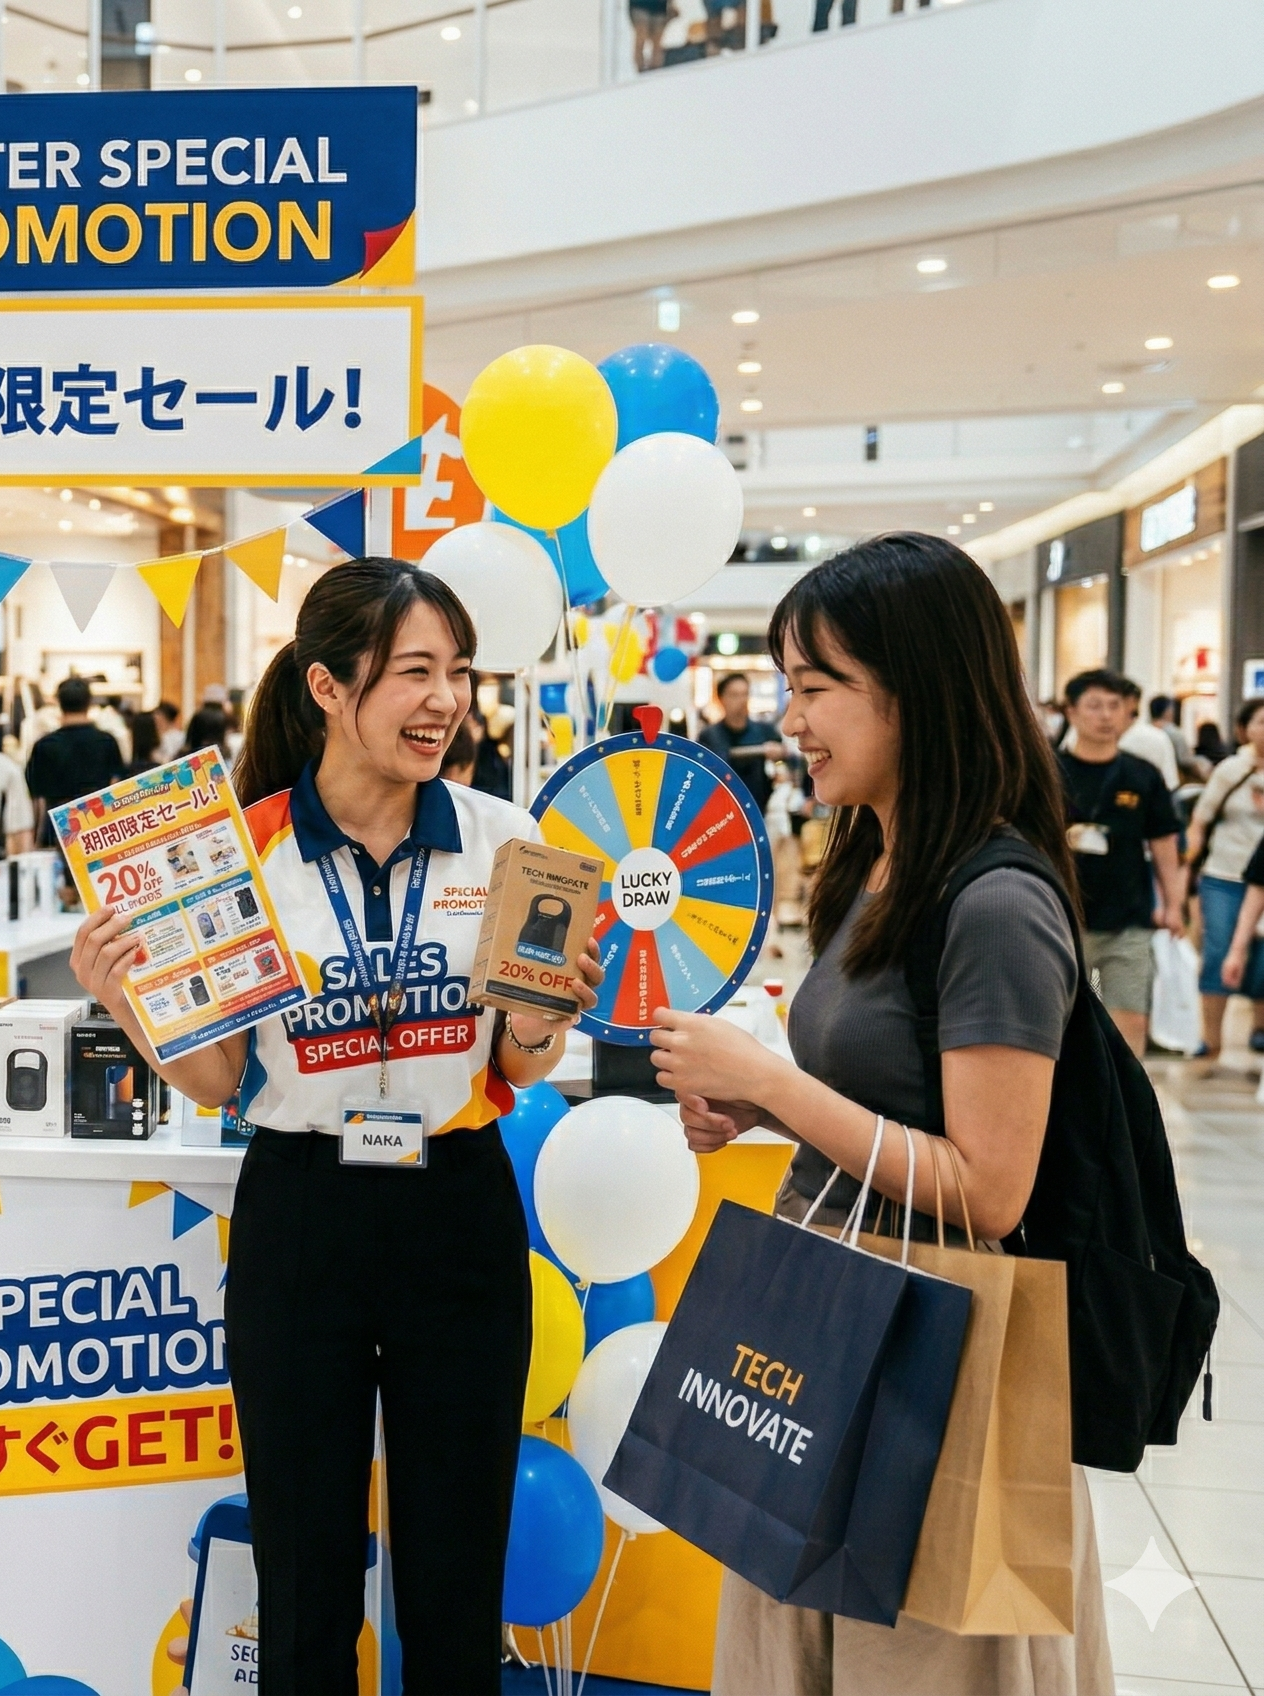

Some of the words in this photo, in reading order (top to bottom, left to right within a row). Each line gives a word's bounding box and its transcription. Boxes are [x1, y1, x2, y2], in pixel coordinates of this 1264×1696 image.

[98, 136, 348, 188] SPECIAL
[97, 861, 156, 905] 20%
[621, 871, 672, 889] LUCKY
[433, 900, 486, 910] PROMOT
[623, 890, 670, 907] DRAW
[499, 961, 534, 982] 20%
[539, 971, 575, 991] OFF
[286, 982, 481, 1033] PROMOTIO
[399, 1024, 468, 1048] OFFER
[362, 1134, 403, 1147] NAKA
[731, 1343, 803, 1406] TECH
[678, 1367, 813, 1465] INNOVATE
